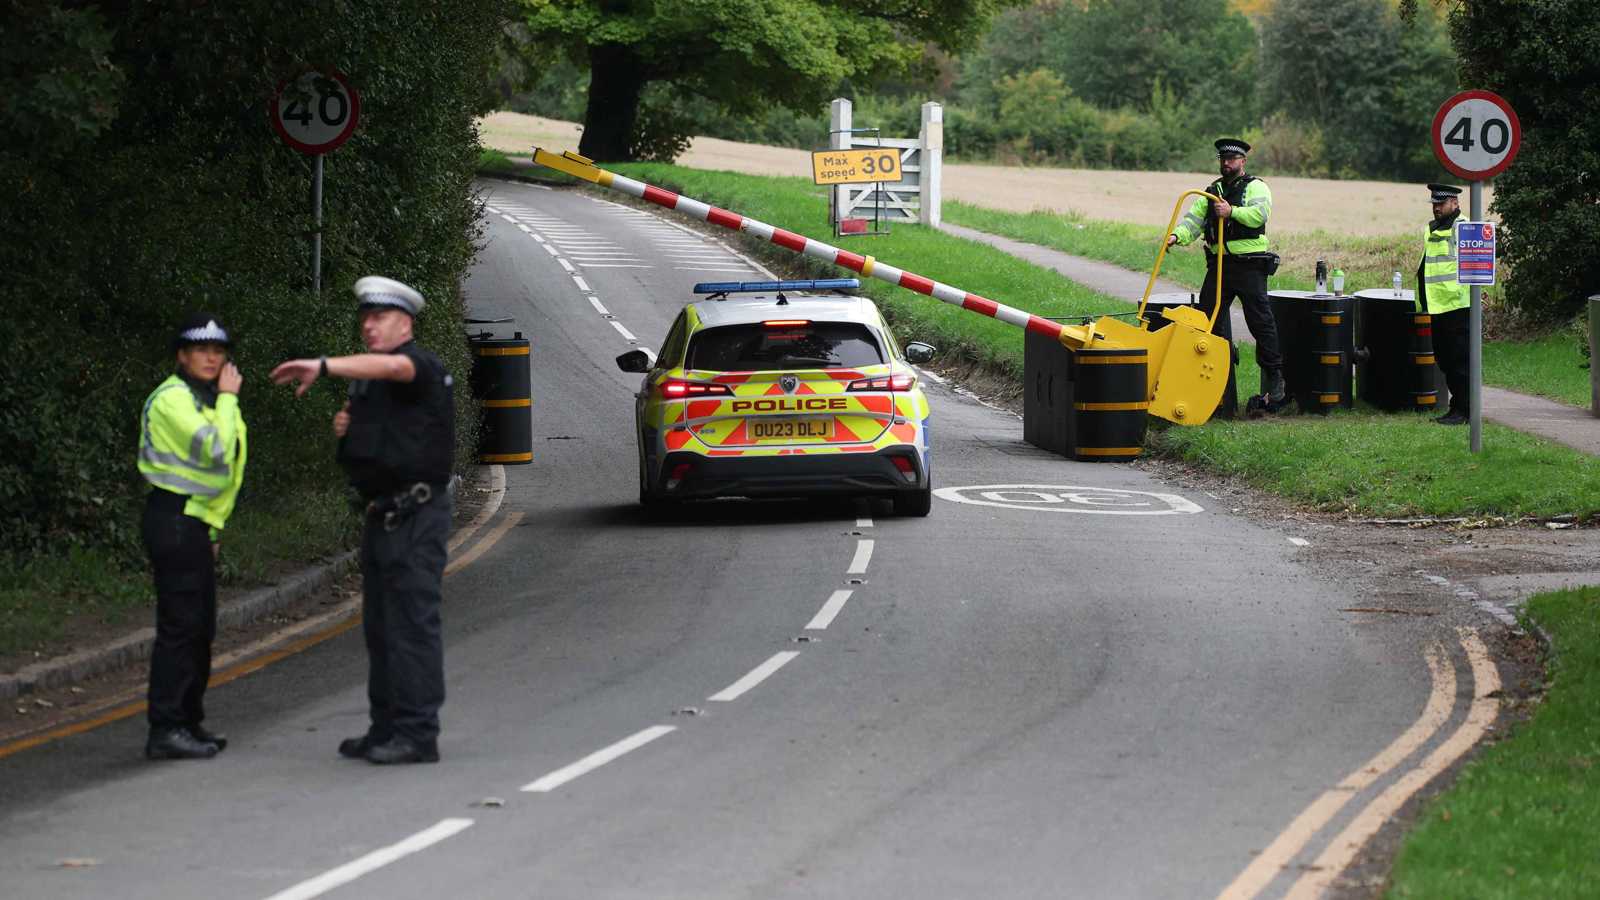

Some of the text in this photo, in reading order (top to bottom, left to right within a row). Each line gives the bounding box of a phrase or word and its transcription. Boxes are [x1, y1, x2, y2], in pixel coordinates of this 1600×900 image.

[283, 89, 347, 126] 40
[1444, 117, 1509, 154] 40
[824, 157, 848, 166] Max
[862, 155, 894, 174] 30
[821, 168, 855, 179] speed
[1460, 240, 1483, 248] STOP
[732, 398, 847, 412] POLICE
[754, 422, 826, 437] OU23 DLJ
